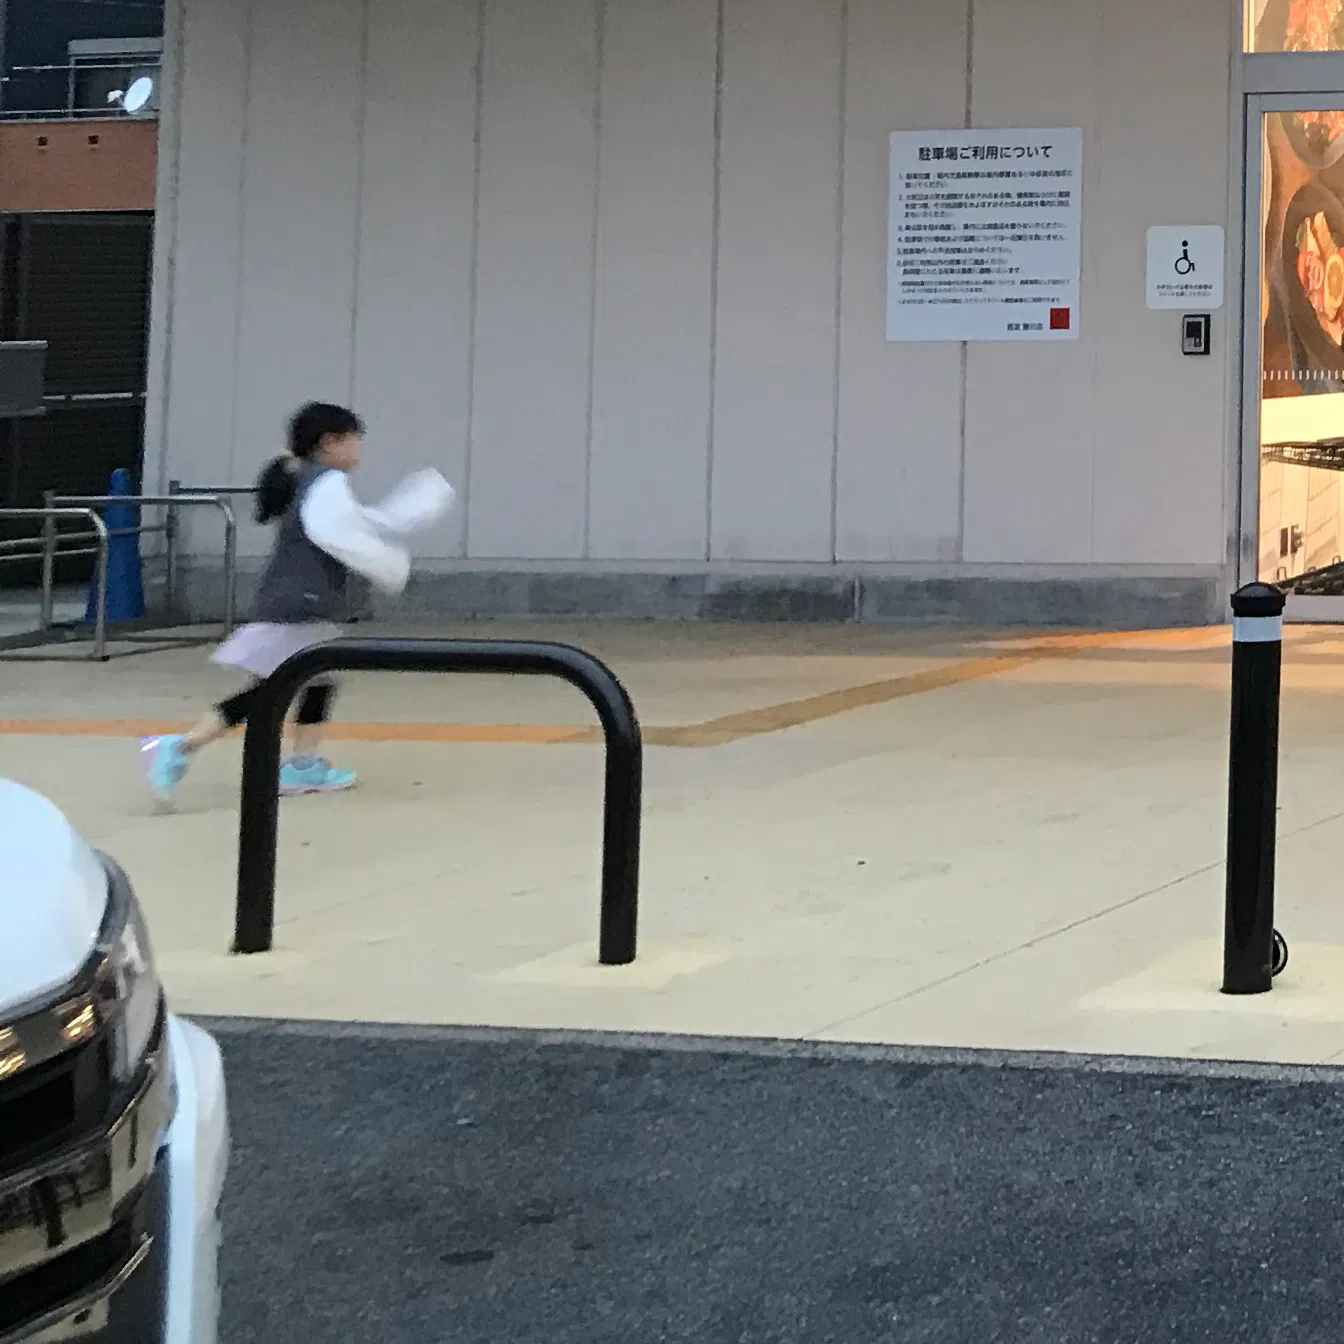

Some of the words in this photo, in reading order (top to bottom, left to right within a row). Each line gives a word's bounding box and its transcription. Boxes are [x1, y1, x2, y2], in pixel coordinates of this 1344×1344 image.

[917, 145, 1053, 162] 駐車場ご利用について
